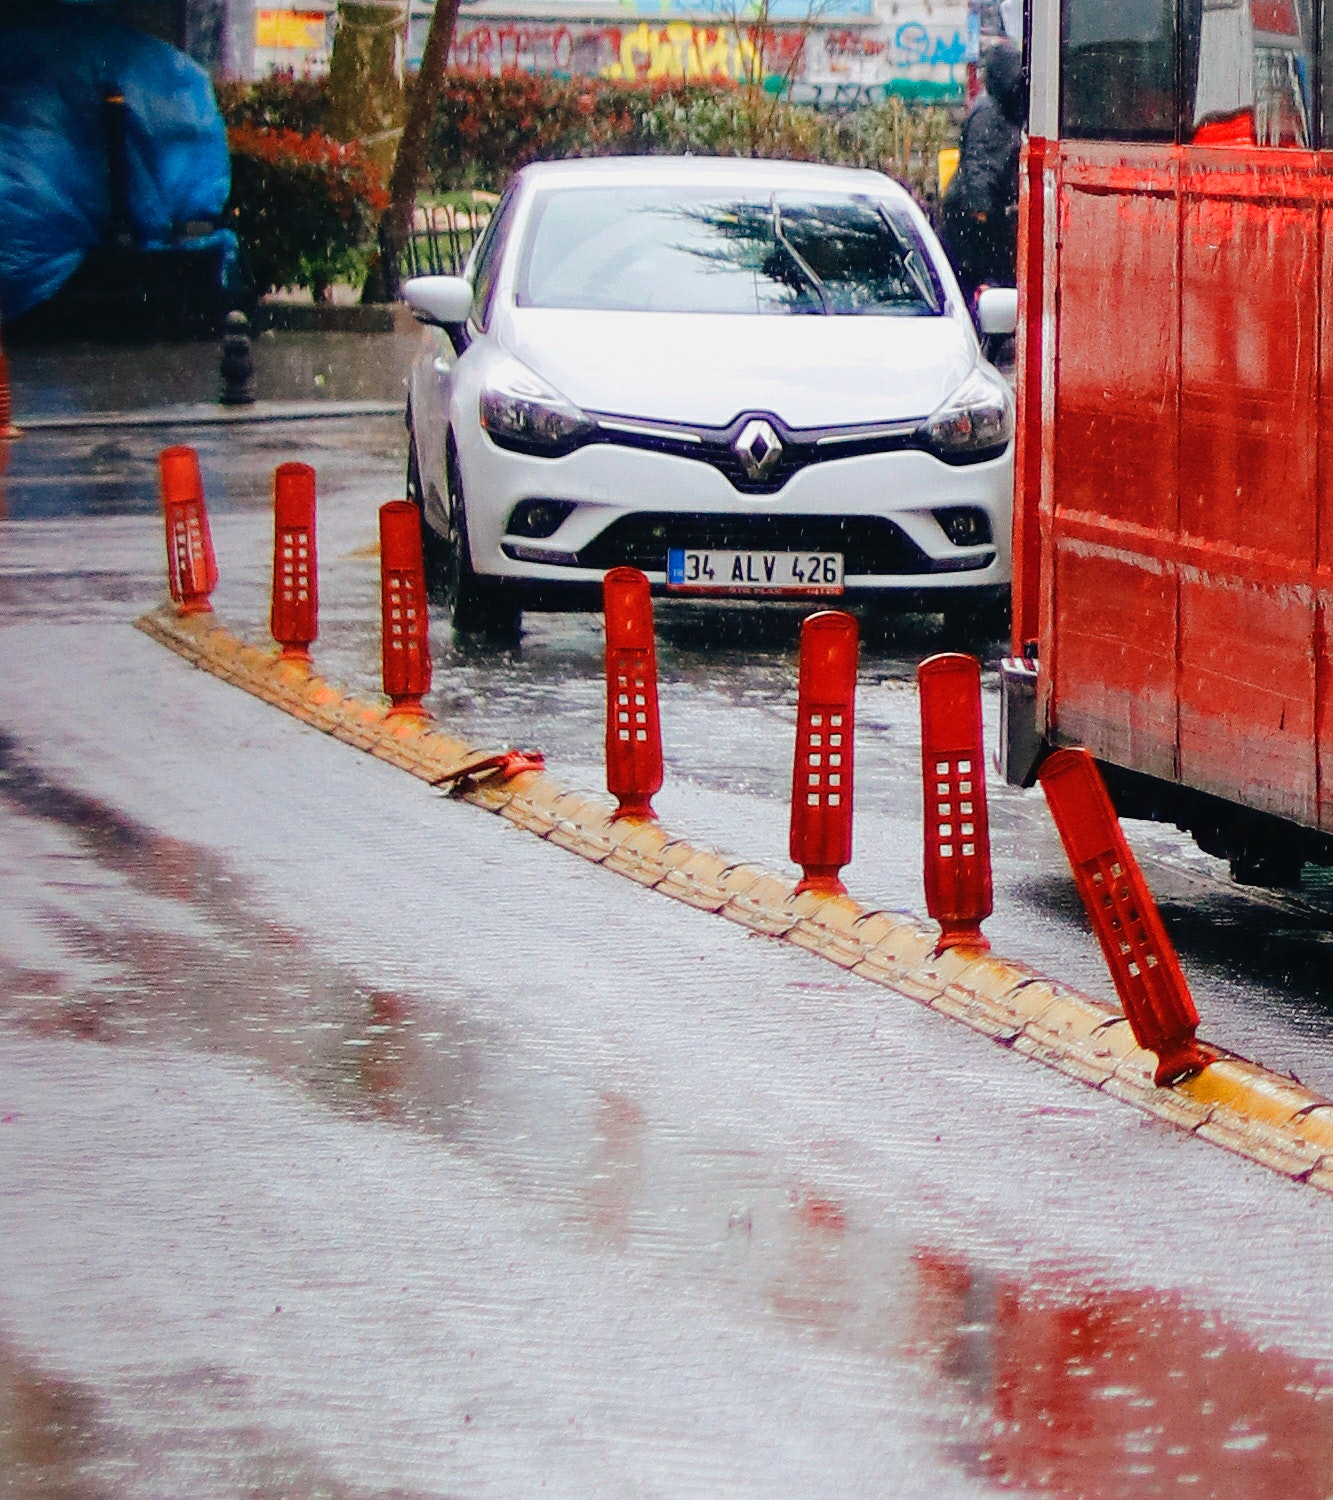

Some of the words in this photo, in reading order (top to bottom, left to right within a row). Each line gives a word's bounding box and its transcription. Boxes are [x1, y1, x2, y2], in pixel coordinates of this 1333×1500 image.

[686, 554, 715, 581] 34
[732, 555, 777, 582] ALV
[792, 556, 837, 583] 426
